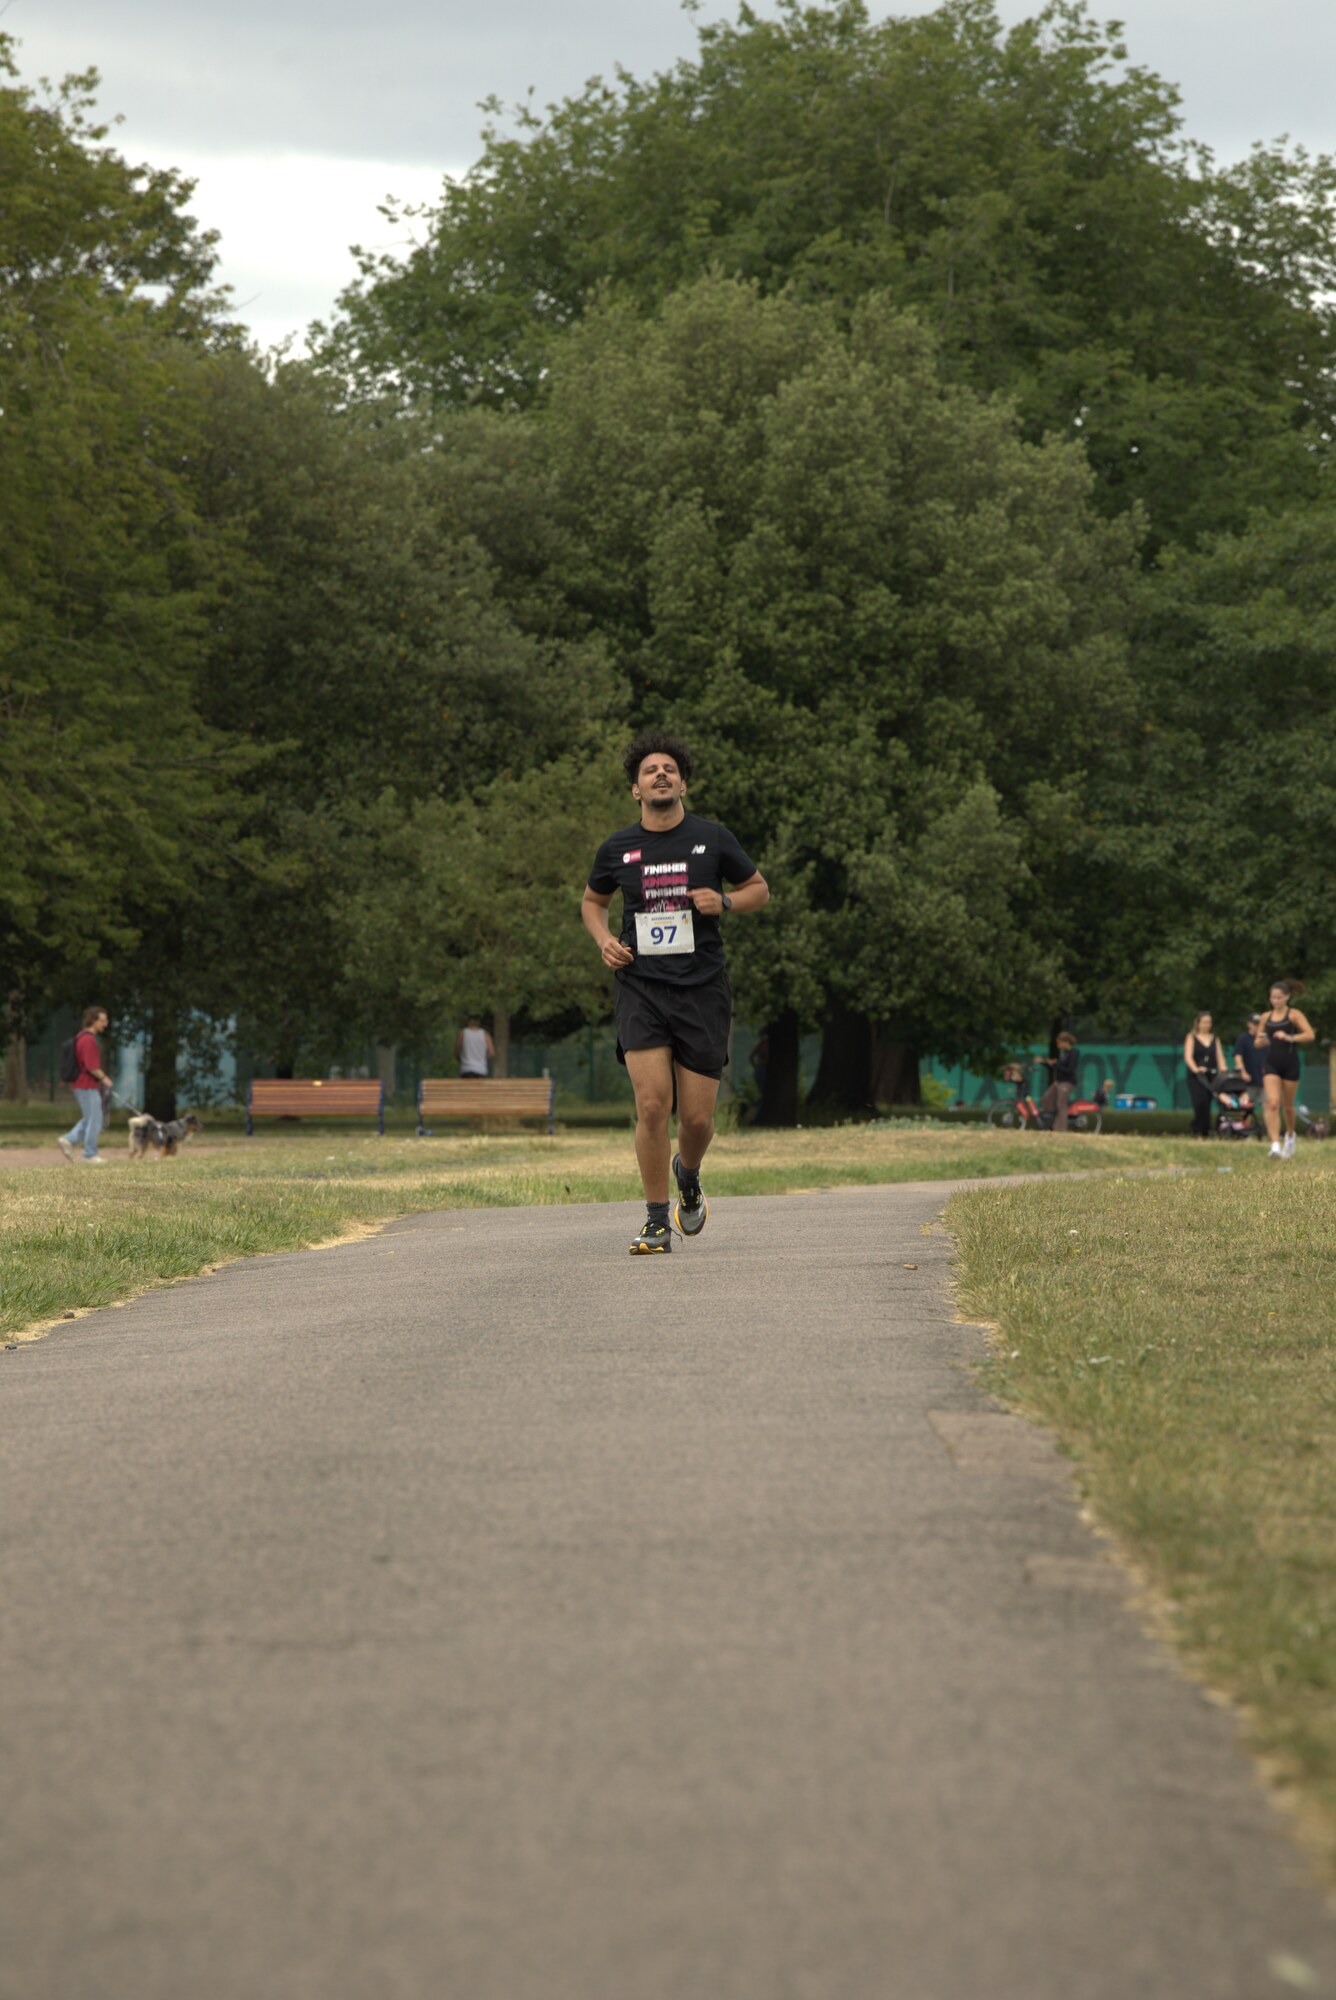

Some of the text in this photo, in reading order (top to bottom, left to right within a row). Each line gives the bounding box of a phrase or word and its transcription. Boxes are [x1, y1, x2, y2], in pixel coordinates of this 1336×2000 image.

[644, 863, 687, 875] FINISHER
[646, 887, 687, 899] FINISHER
[650, 925, 678, 945] 97
